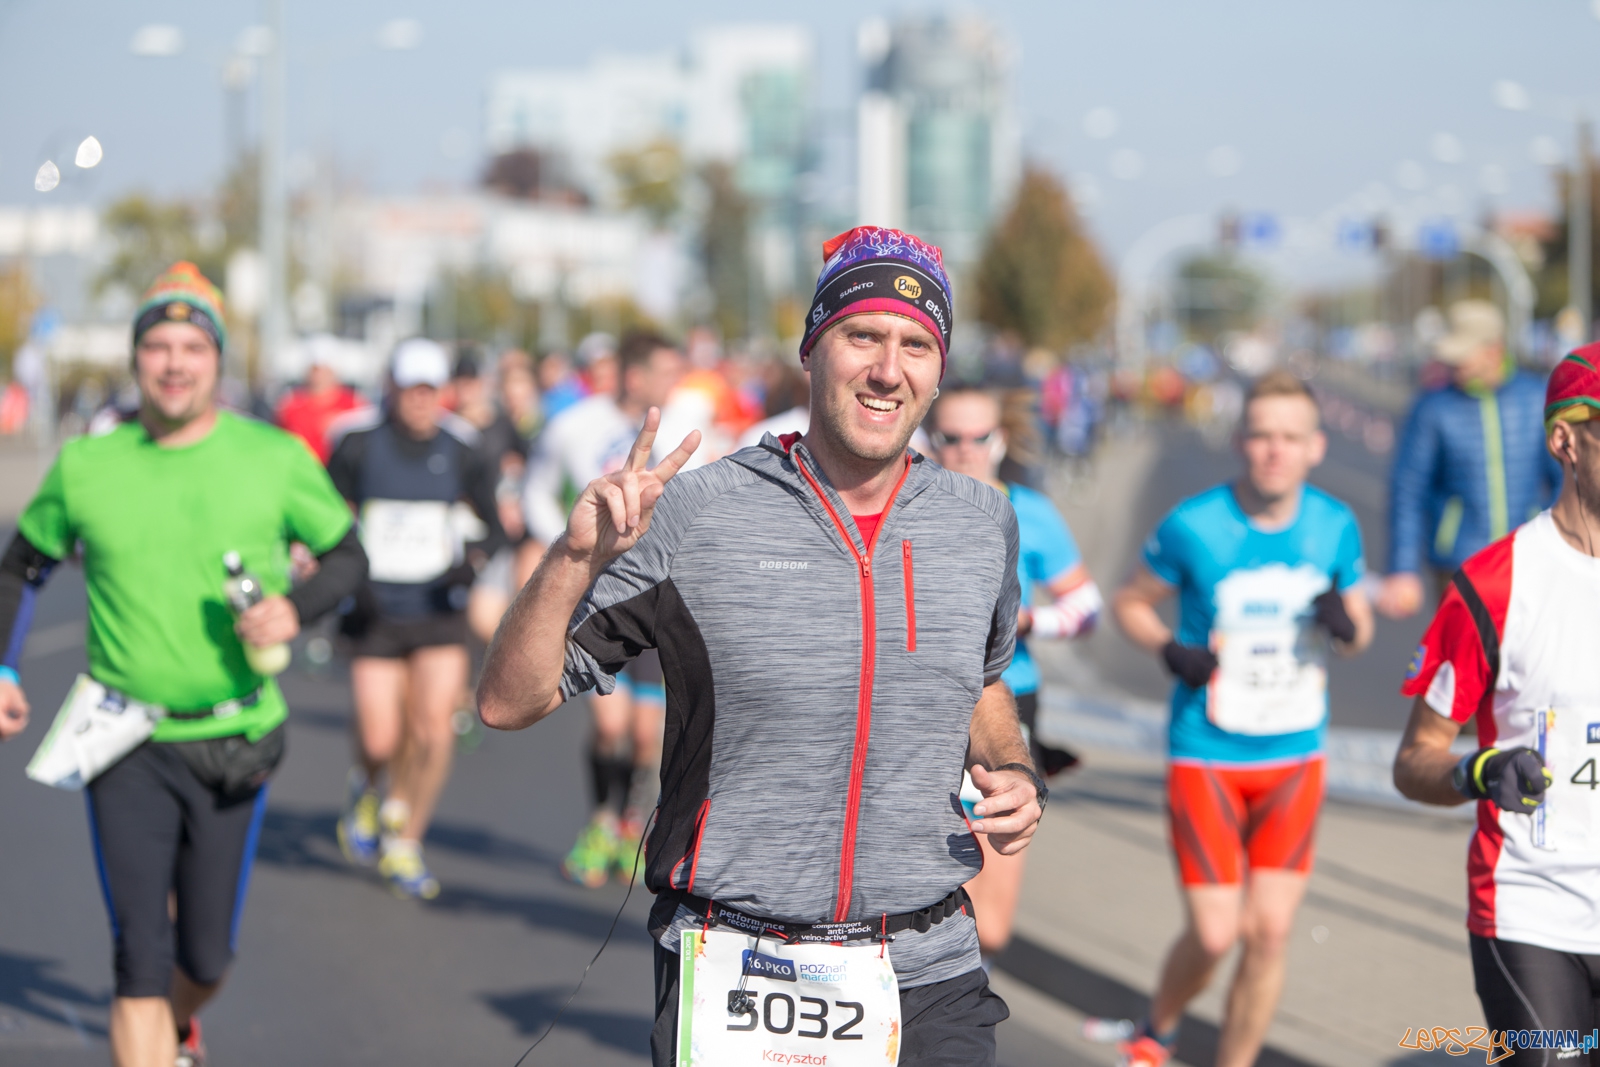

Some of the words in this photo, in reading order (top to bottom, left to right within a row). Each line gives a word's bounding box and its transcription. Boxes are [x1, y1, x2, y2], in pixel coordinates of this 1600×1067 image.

[839, 281, 874, 299] SUUNTO
[898, 278, 920, 297] Buff
[760, 560, 808, 570] DOBSOM
[719, 908, 785, 931] performnce
[827, 925, 872, 935] anti-shock
[801, 973, 847, 982] maraton
[727, 989, 864, 1041] 5032
[763, 1049, 827, 1065] Krzysztof
